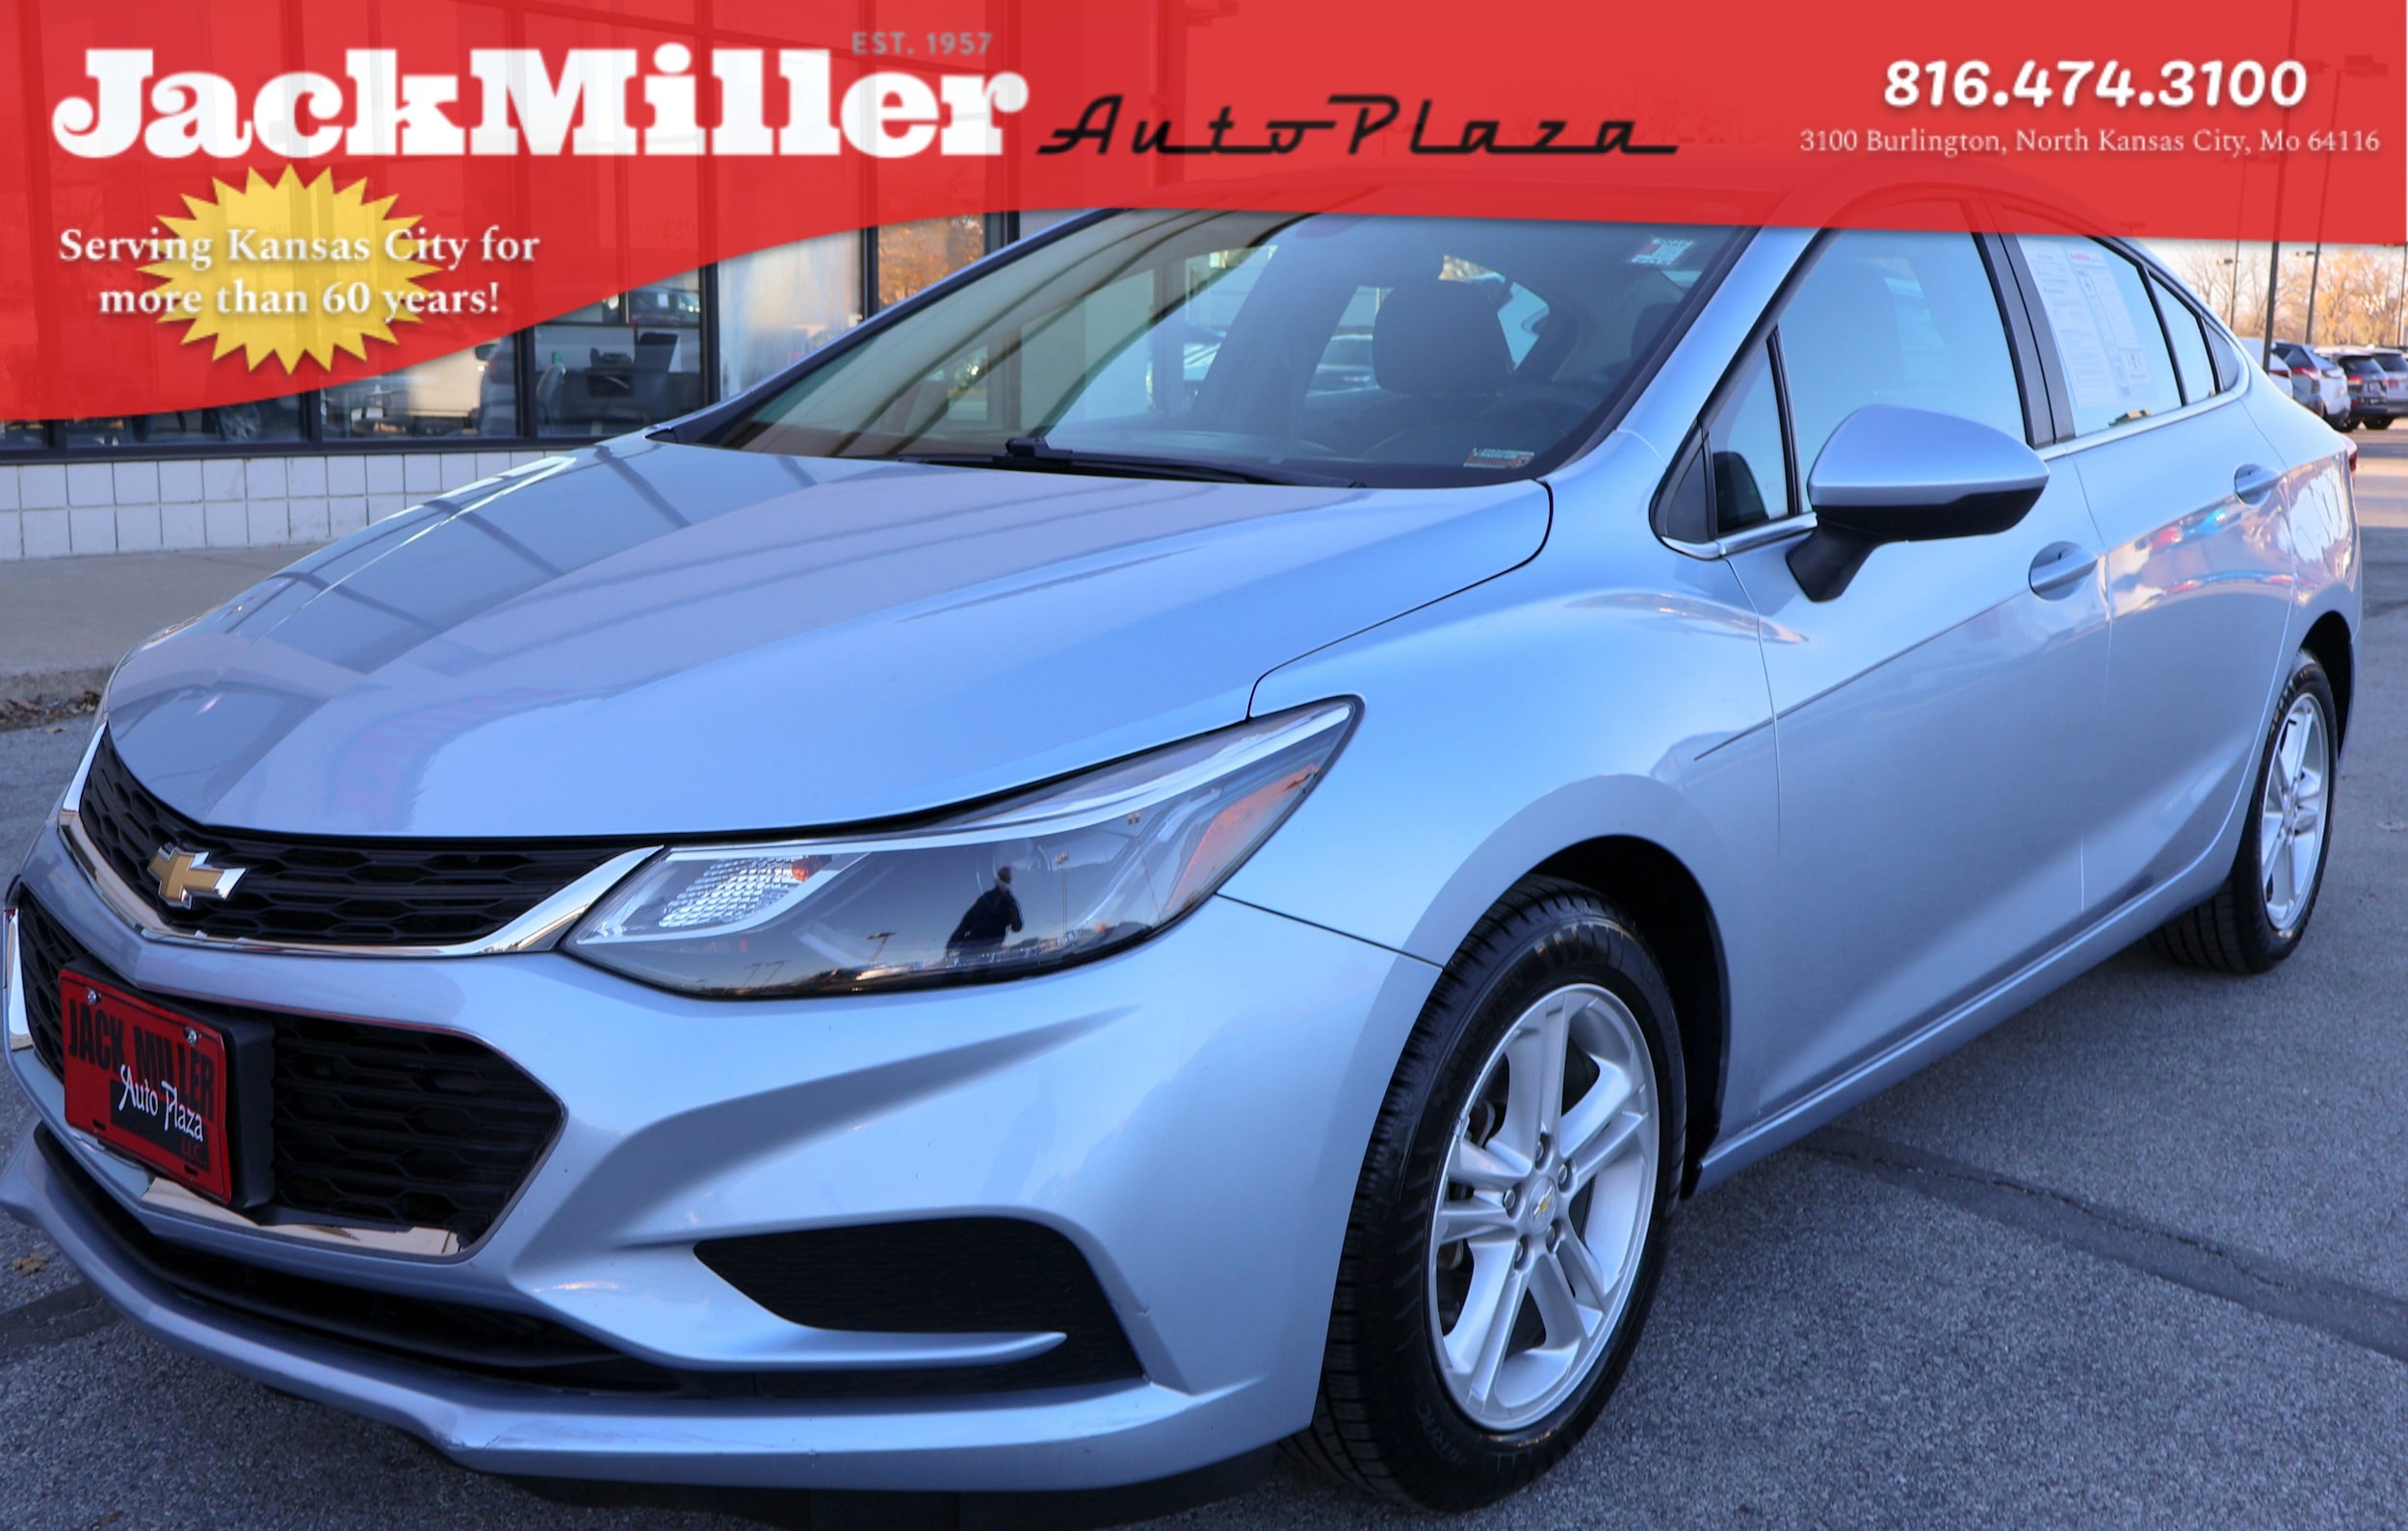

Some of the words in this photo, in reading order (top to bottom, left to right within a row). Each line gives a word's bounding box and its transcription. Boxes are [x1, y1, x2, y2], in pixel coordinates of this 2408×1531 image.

[67, 999, 124, 1073] JACK
[132, 1025, 215, 1122] MILLER
[118, 1063, 159, 1118] Auto
[160, 1079, 204, 1143] Plaza
